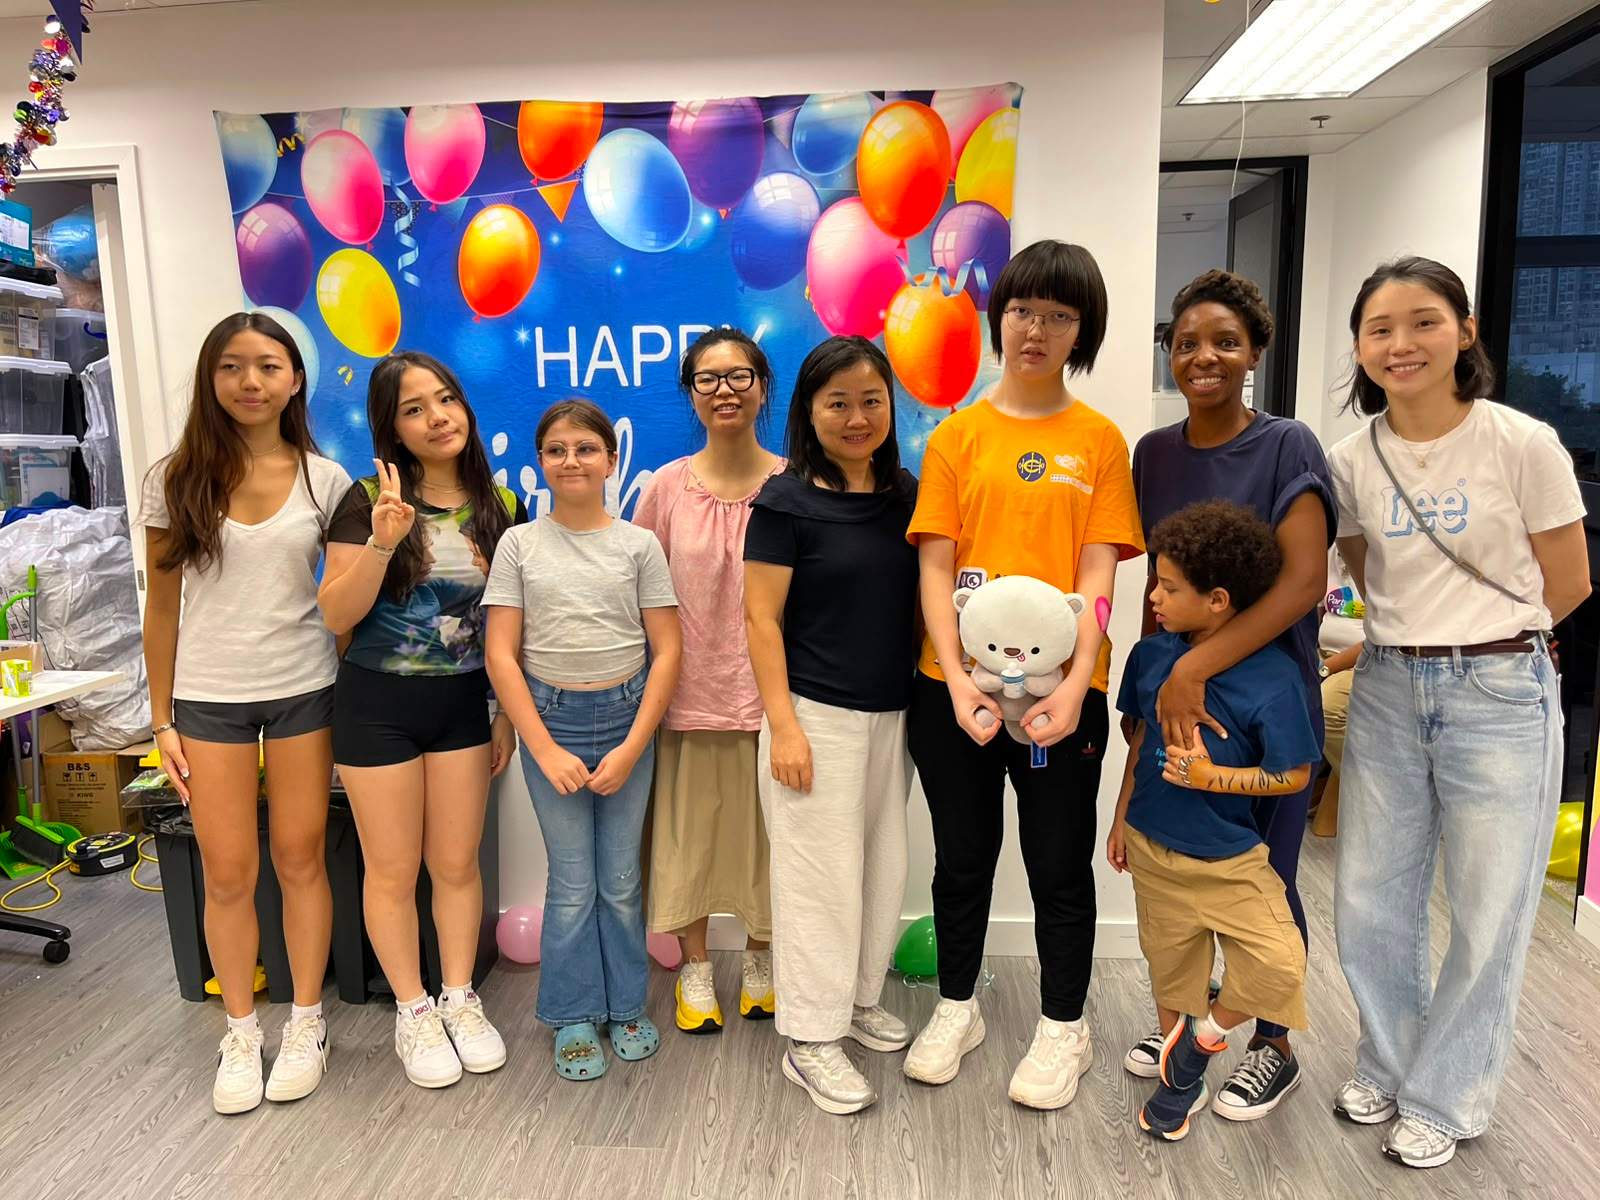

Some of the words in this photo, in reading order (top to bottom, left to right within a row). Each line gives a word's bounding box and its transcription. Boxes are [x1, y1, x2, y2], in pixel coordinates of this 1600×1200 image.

[534, 324, 768, 388] HAP
[1381, 487, 1468, 538] Lee
[67, 762, 91, 771] B&S
